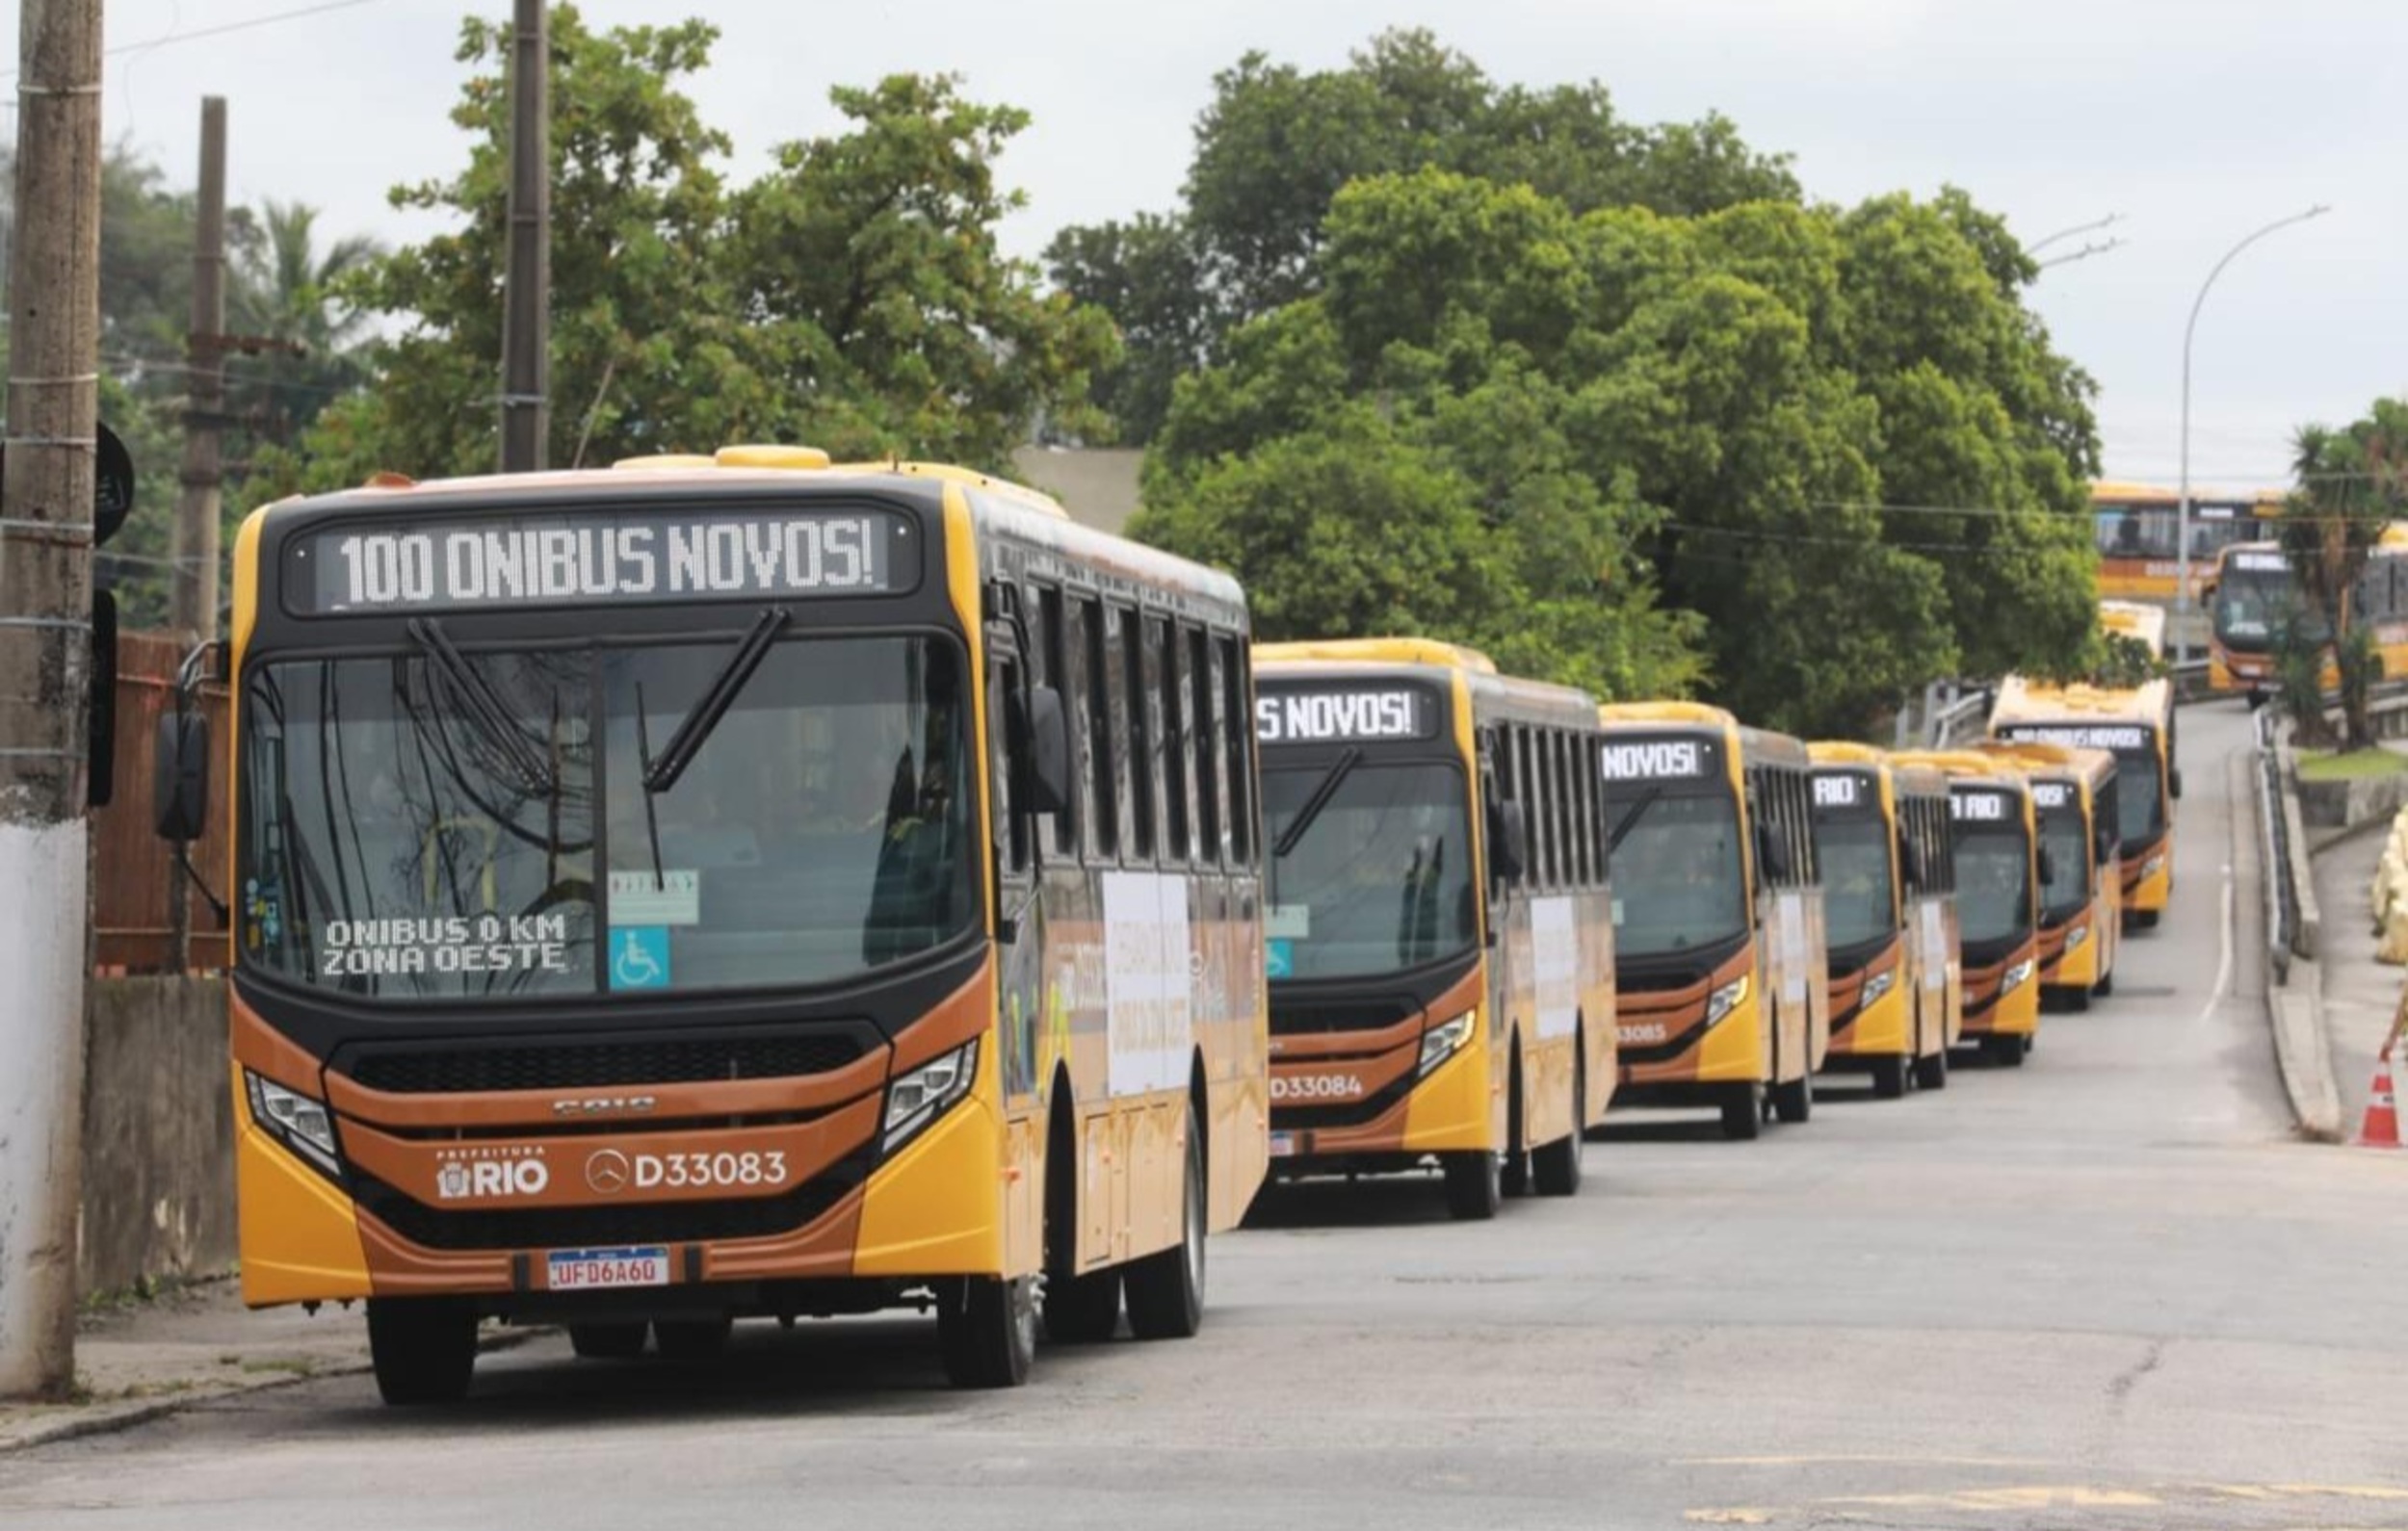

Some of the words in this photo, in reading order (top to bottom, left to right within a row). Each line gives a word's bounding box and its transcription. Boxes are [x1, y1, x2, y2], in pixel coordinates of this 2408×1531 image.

[340, 532, 434, 604] 100
[446, 525, 657, 600] ONIBUS
[667, 517, 874, 593] NOVOS!
[1286, 690, 1412, 739] NOVOS!
[1602, 740, 1697, 780] NOVOS!
[1813, 776, 1855, 806] RIO
[1966, 793, 2002, 819] RIO
[326, 916, 471, 947] ONIBUS
[480, 915, 501, 943] 0
[510, 914, 566, 942] KM
[323, 946, 426, 975] ZONA
[433, 942, 566, 972] OESTE
[1269, 1075, 1363, 1099] D33084
[435, 1146, 546, 1160] PREFEITURA
[634, 1152, 787, 1187] D33083
[473, 1158, 549, 1196] RIO
